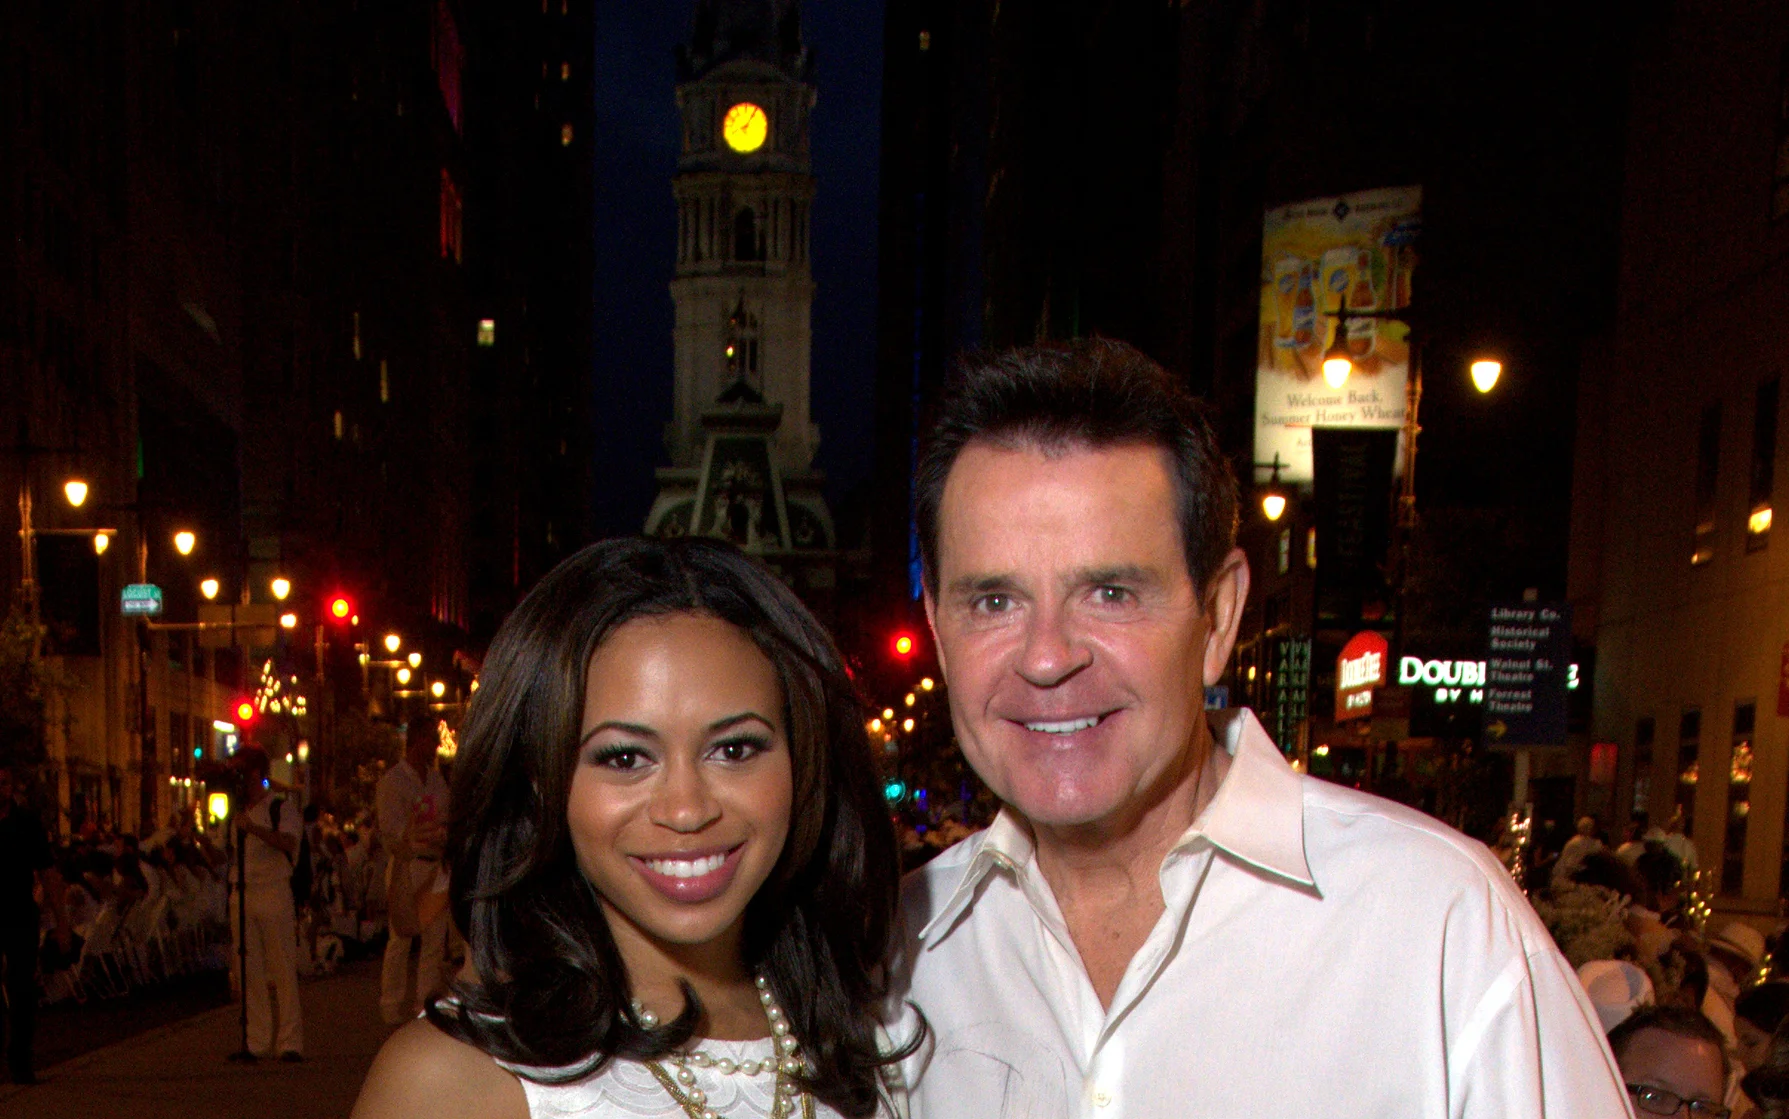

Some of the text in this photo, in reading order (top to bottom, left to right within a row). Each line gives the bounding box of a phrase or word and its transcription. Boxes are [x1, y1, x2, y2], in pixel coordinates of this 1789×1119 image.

[1288, 393, 1342, 407] Welcome
[1262, 412, 1311, 425] Summer
[1316, 408, 1355, 422] Honey
[1491, 607, 1560, 621] Library Co.
[1490, 625, 1549, 637] Historical
[1491, 638, 1536, 651] Society
[1490, 659, 1531, 670] Walnut
[1490, 670, 1534, 682] Theatre
[1488, 688, 1532, 700] Forrest
[1489, 701, 1533, 713] Theatre
